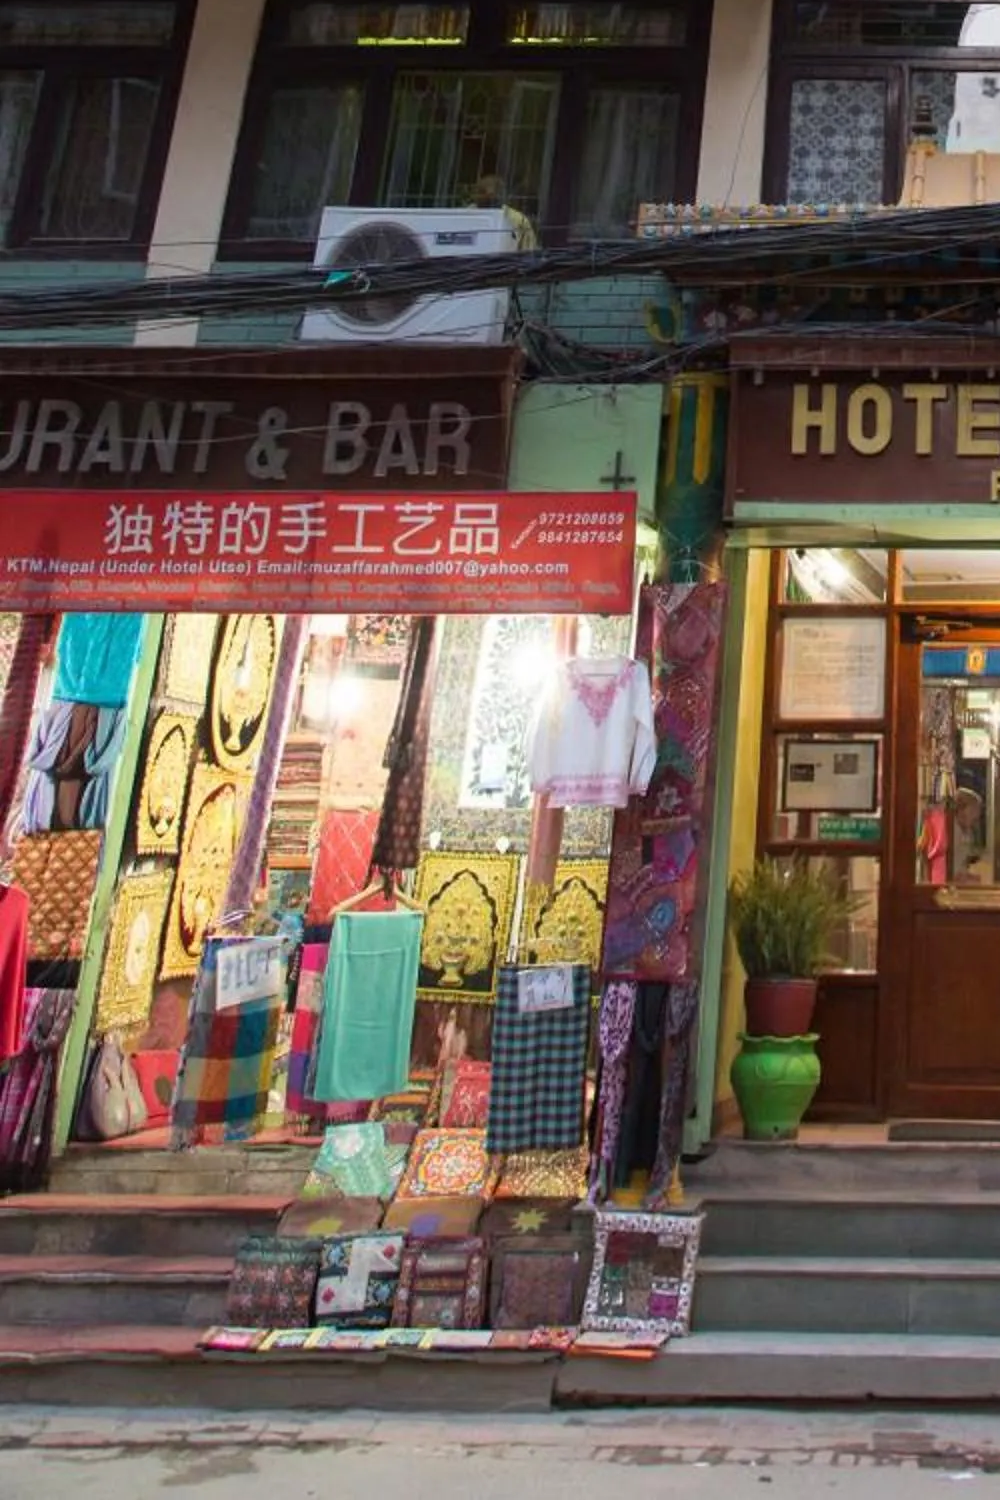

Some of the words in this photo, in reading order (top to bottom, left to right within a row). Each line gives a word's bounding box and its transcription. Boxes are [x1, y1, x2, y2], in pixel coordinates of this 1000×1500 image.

[245, 406, 289, 480] &
[323, 402, 472, 477] BAR
[104, 501, 500, 555] 独特的手工艺品
[100, 560, 154, 576] (Under
[160, 560, 203, 573] Hotel
